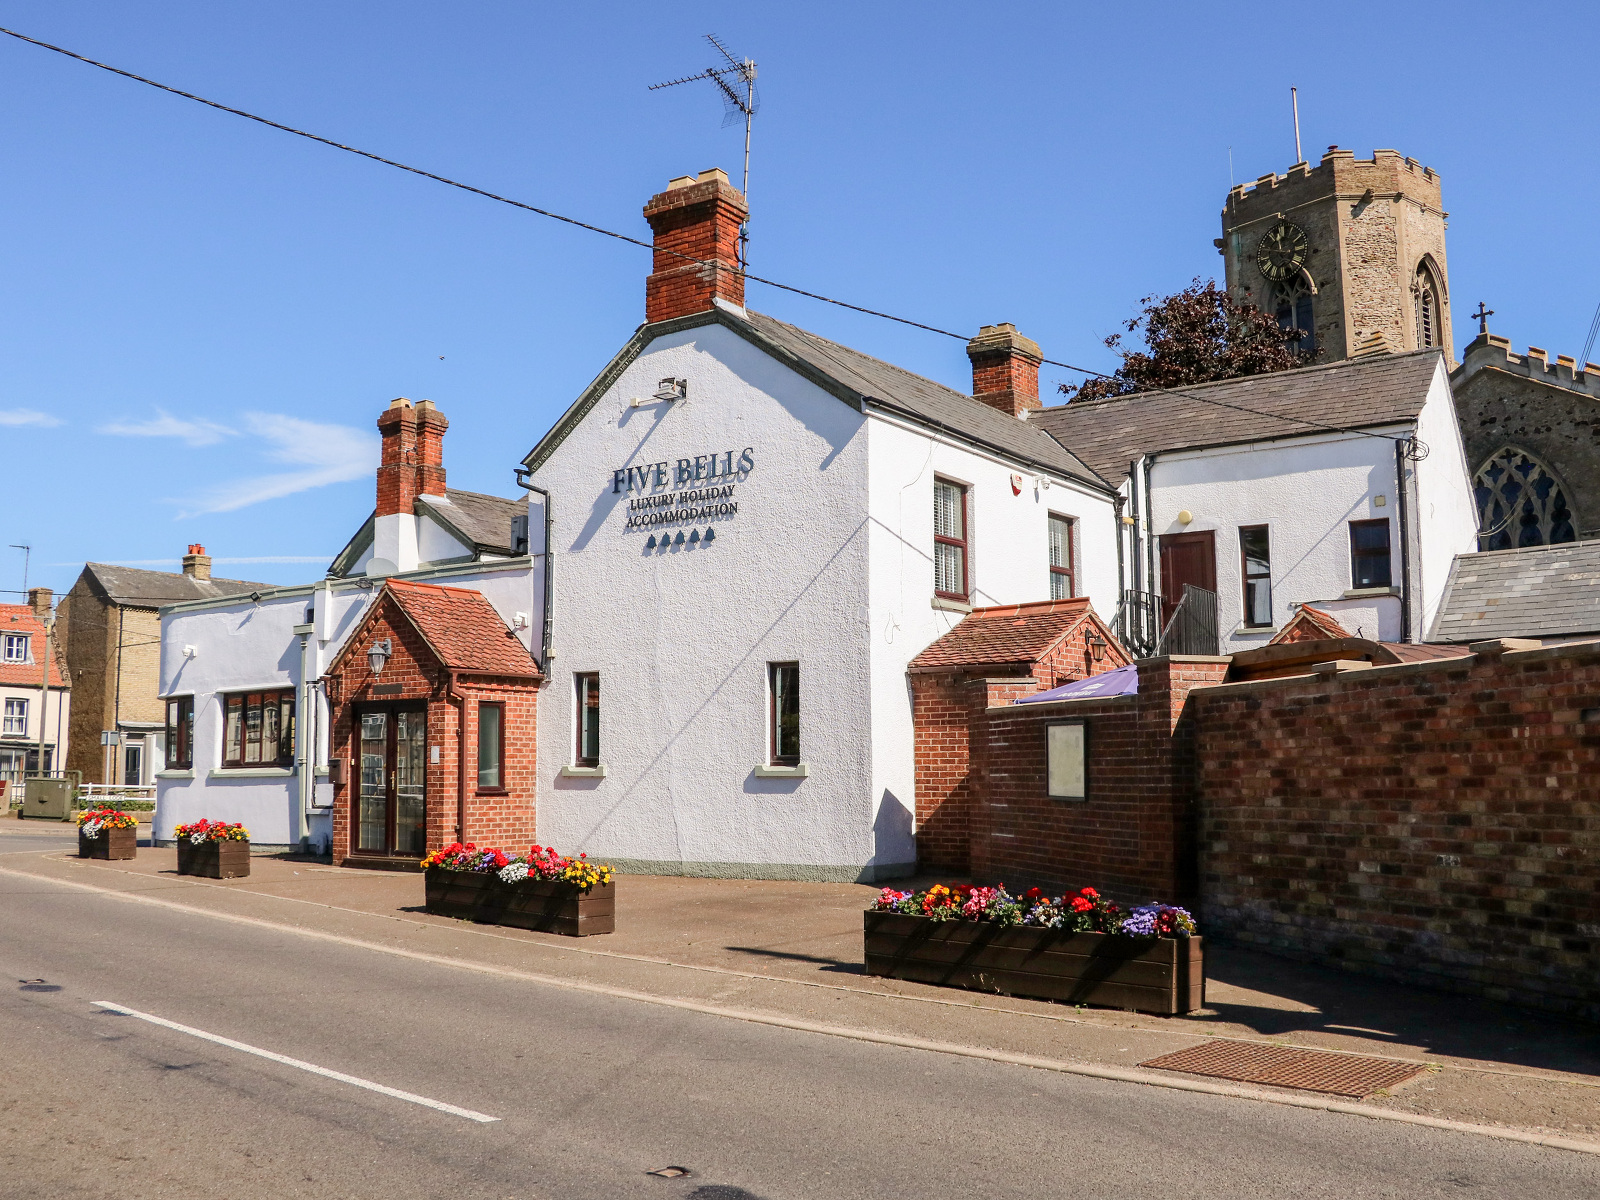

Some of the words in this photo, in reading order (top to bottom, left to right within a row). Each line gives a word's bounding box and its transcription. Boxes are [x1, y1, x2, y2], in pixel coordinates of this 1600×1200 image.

[612, 461, 669, 493] FIVE
[676, 447, 754, 484] BELLS
[630, 493, 675, 510] LUXURY
[679, 485, 735, 503] HOLIDAY
[627, 502, 738, 527] ACCOMMODATION
